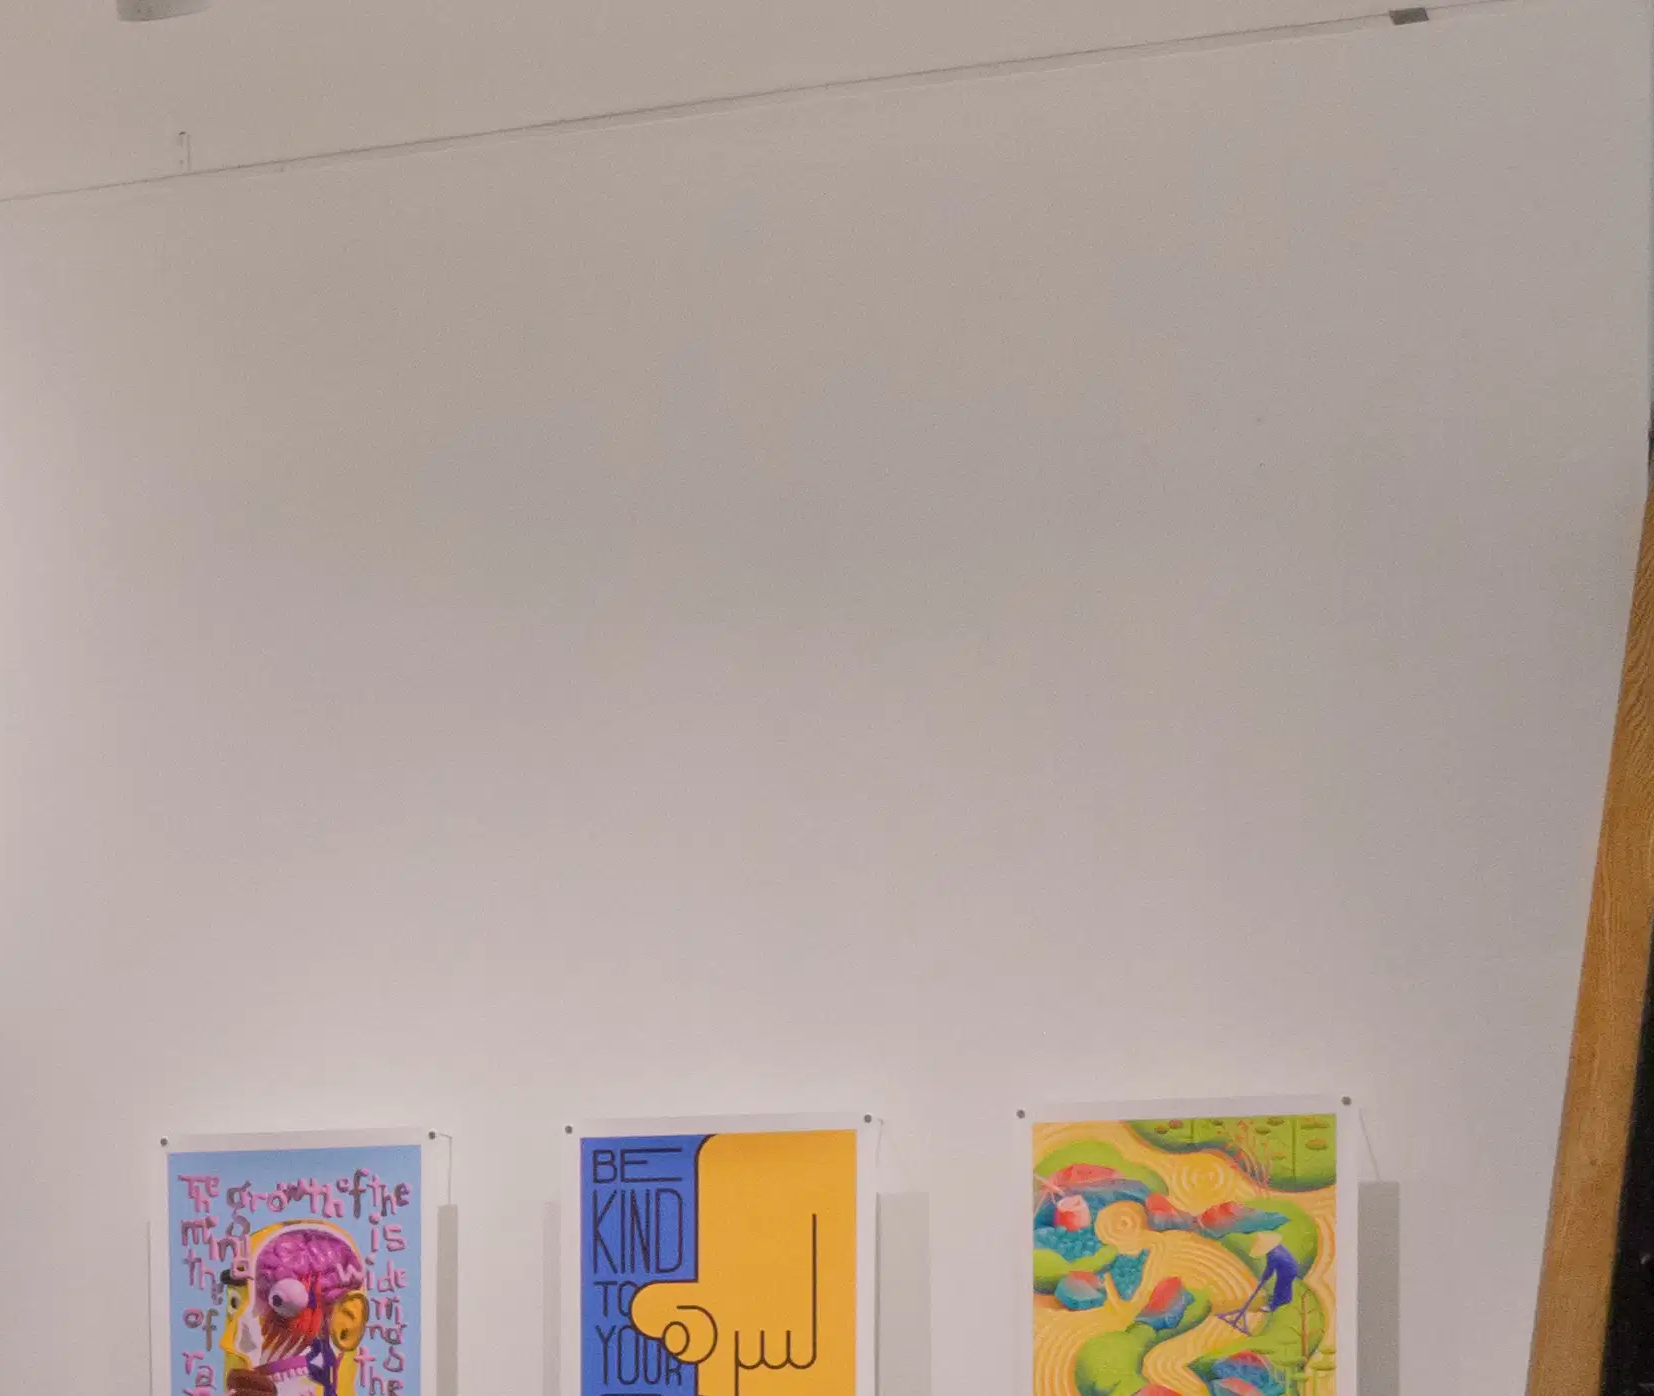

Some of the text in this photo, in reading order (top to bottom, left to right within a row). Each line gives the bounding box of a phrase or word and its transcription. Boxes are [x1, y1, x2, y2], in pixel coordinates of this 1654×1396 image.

[592, 1148, 683, 1184] BE
[368, 1174, 413, 1217] the
[592, 1187, 684, 1274] KIND
[593, 1280, 639, 1318] TO
[182, 1307, 221, 1352] of
